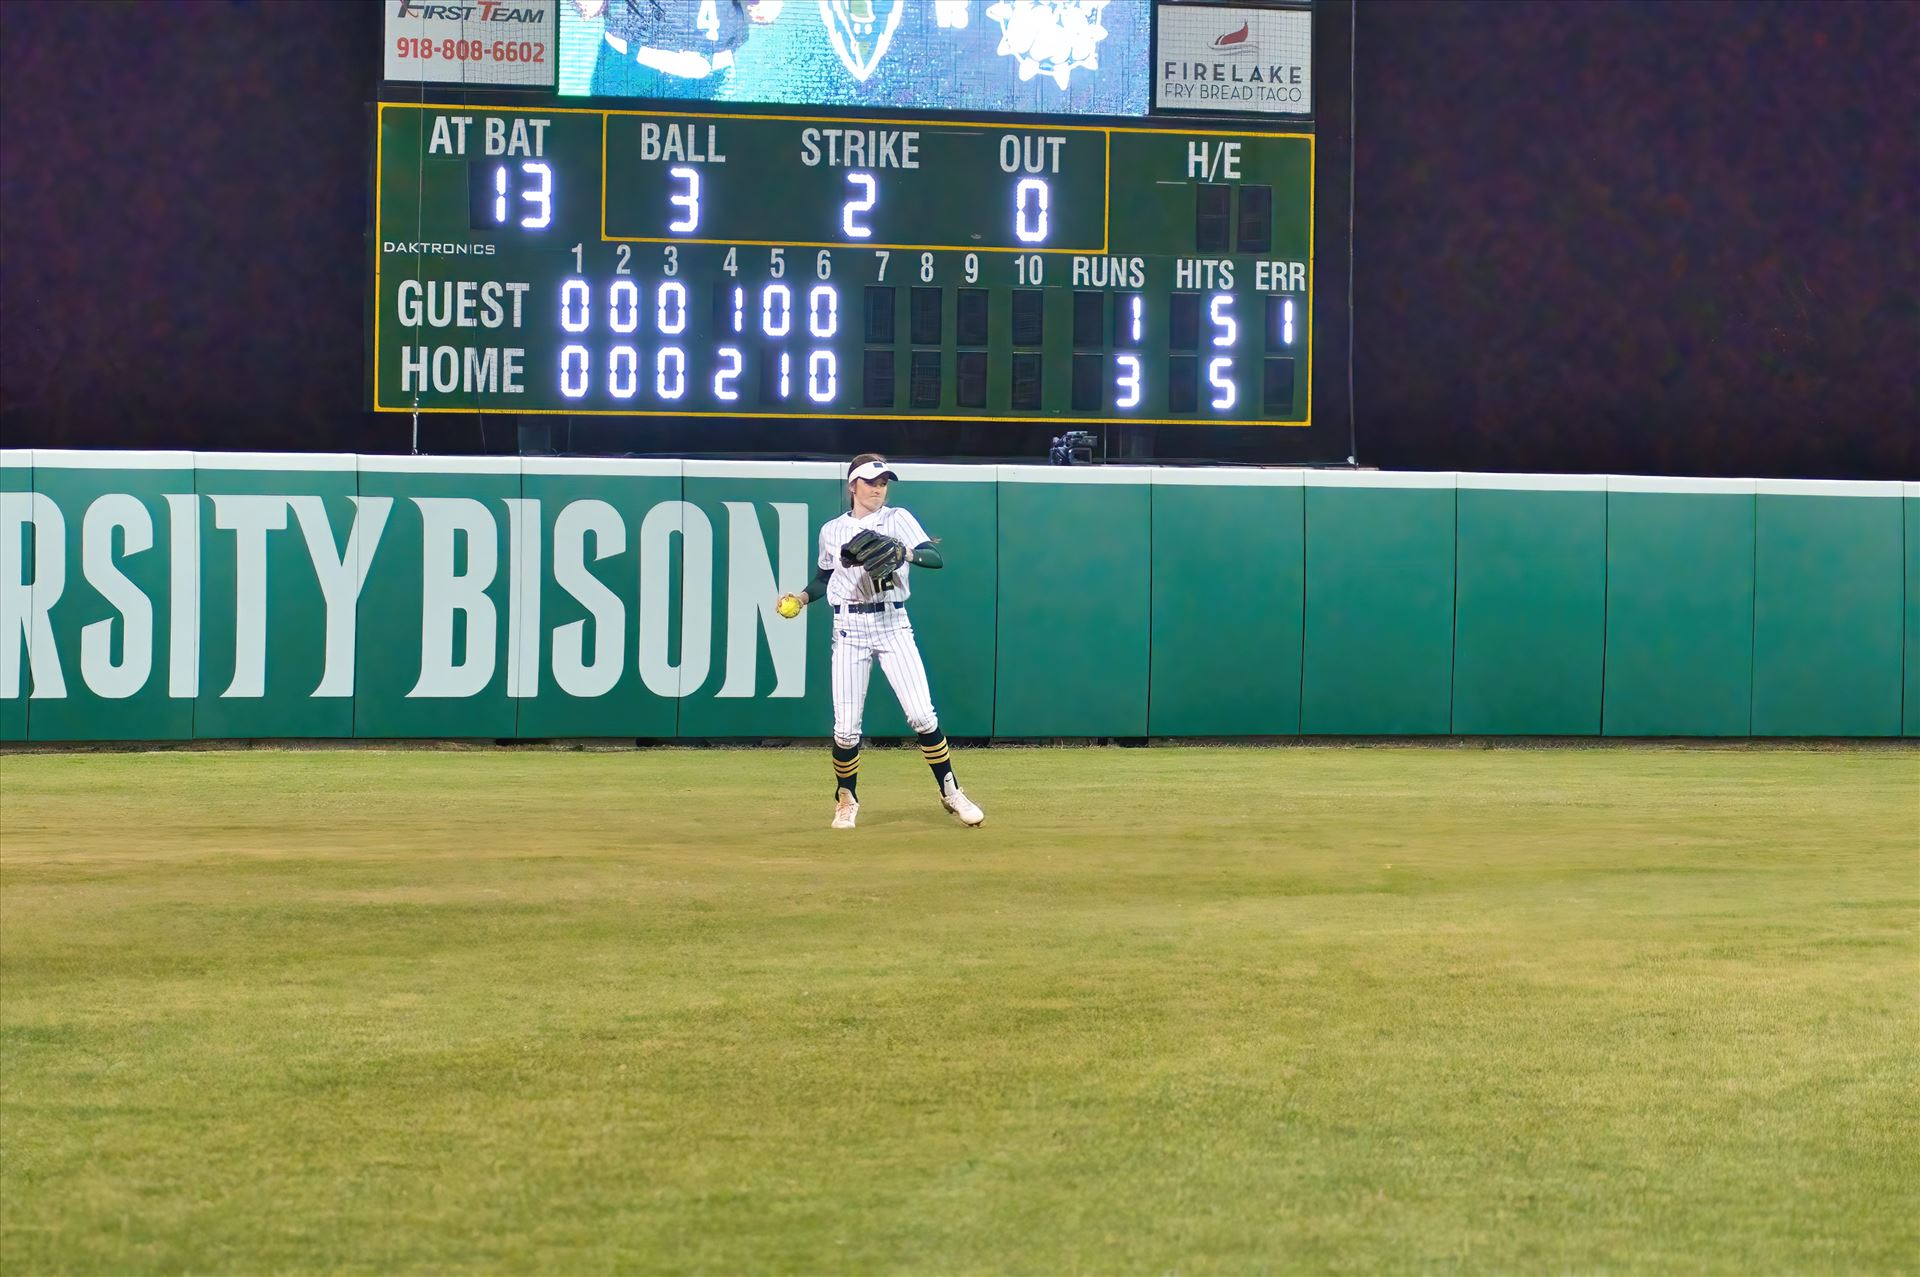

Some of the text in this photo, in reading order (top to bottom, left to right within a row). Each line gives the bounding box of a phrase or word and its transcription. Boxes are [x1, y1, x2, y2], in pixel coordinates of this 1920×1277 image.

[397, 0, 545, 23] FIRST TEAM
[396, 37, 545, 63] 918-808-6602
[1164, 61, 1302, 84] FIRELAKE
[1165, 83, 1302, 102] FRY BREAD TACO
[429, 116, 550, 158] AT BAT
[642, 123, 725, 163] BALL
[801, 128, 919, 169] STRIKE
[1000, 135, 1065, 173] OUT
[1189, 142, 1241, 181] H/E
[496, 164, 551, 227] 13
[670, 168, 699, 231] 3
[844, 174, 875, 237] 2
[1017, 179, 1048, 241] 0
[384, 242, 495, 254] DAKTRONICS
[572, 243, 1305, 291] 1 2 3 4 5 6 7 8 9 10 RUNS HITS ERR
[398, 280, 529, 327] GUEST
[562, 280, 1293, 346] 0 0 0 1 0 0 1 5 1
[402, 346, 524, 392] HOME
[561, 345, 1235, 408] 0 0 0 2 1 0 3 5
[406, 498, 808, 697] BISON
